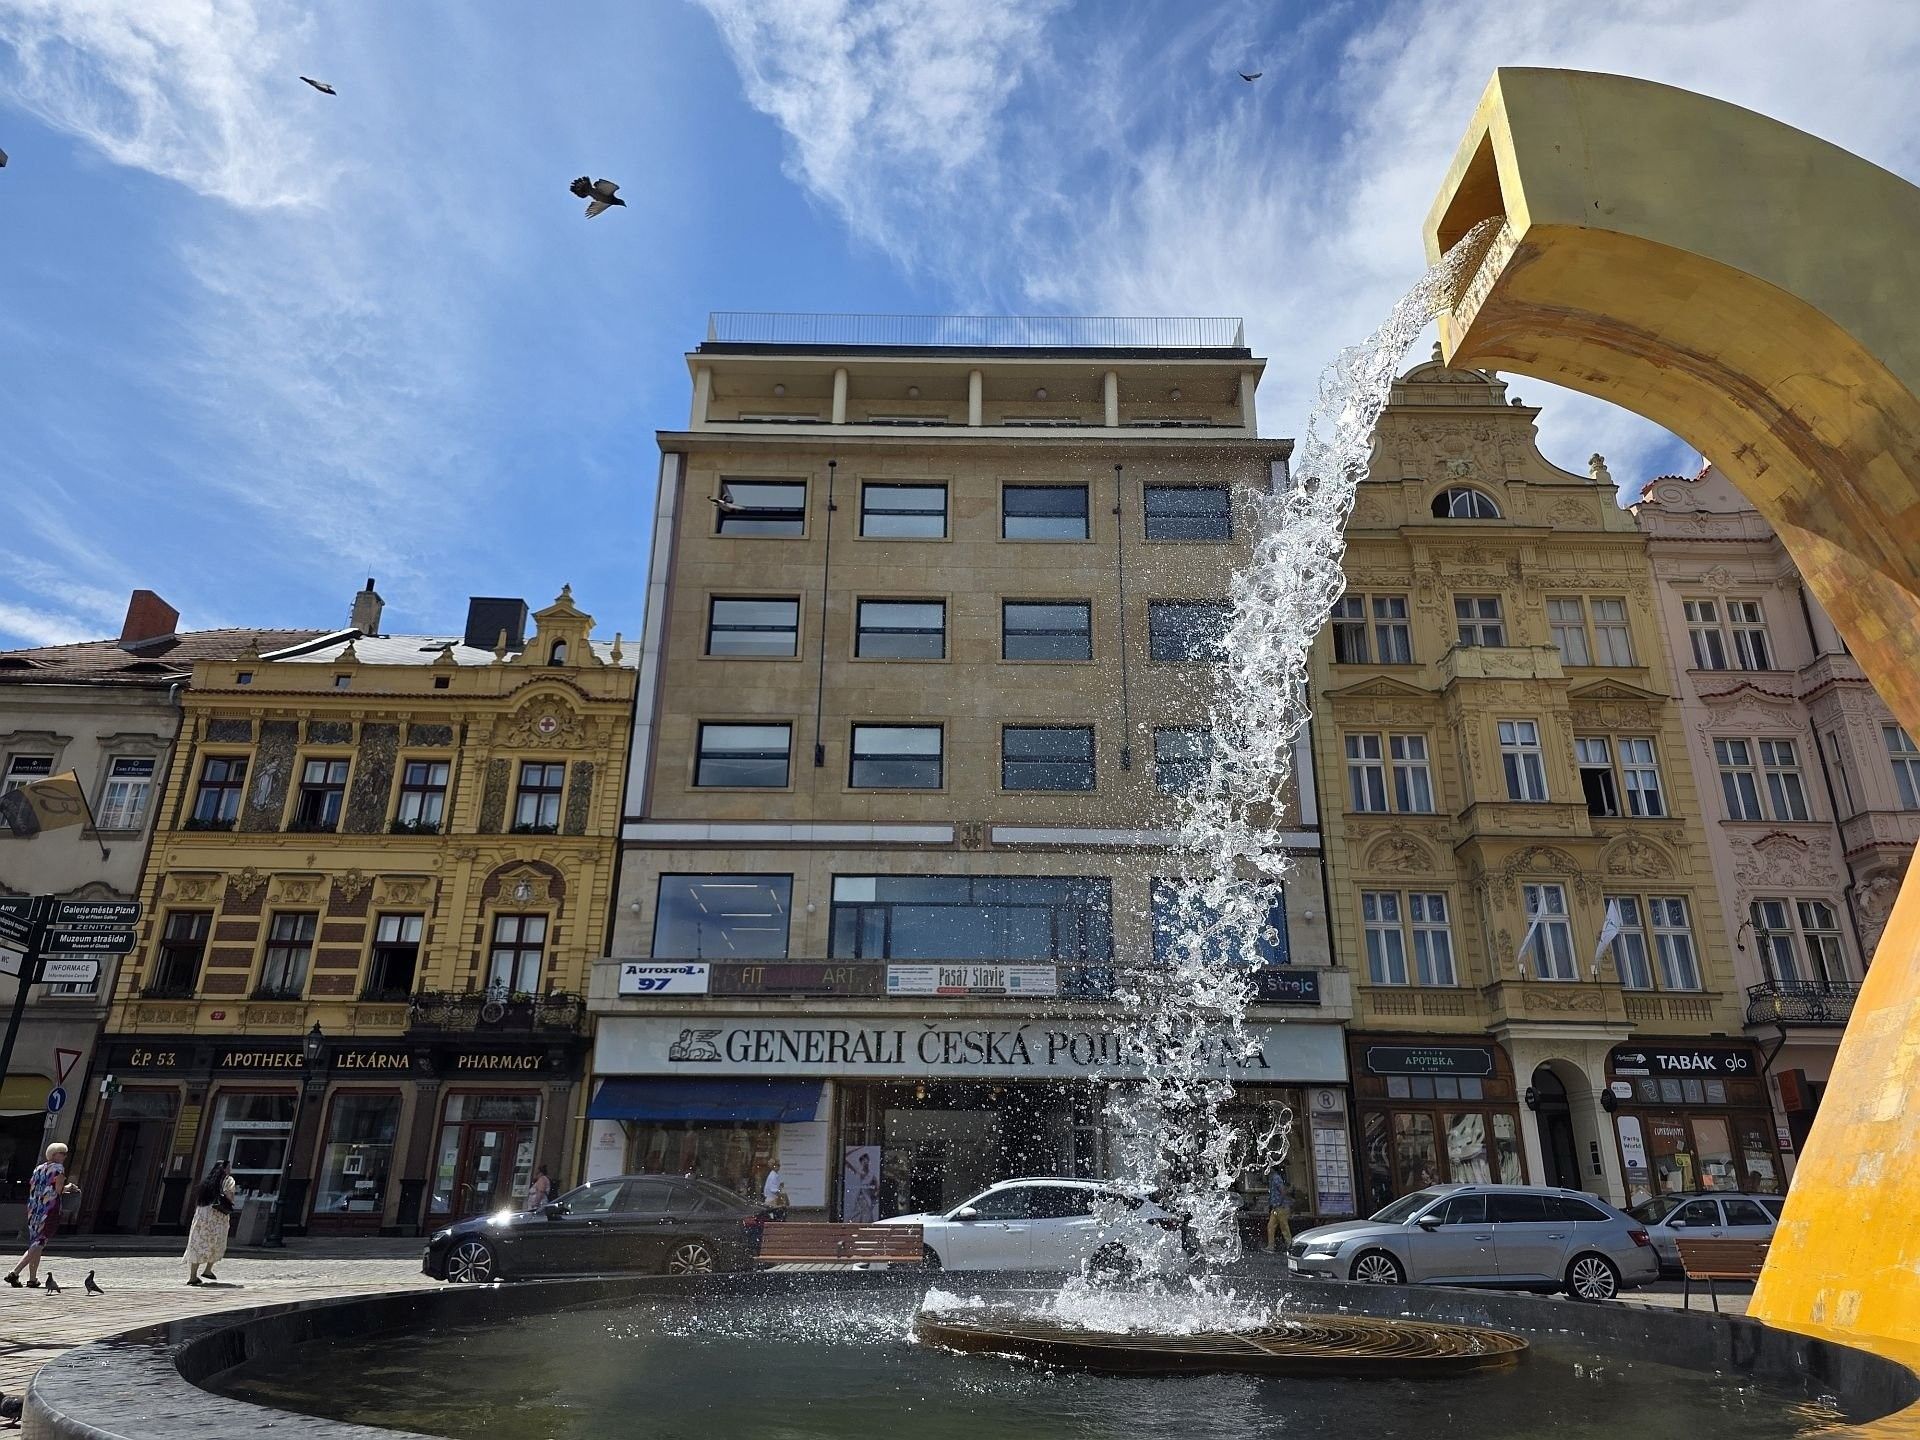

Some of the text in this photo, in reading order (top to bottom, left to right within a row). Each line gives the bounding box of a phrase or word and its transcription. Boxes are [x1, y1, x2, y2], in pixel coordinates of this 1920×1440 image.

[63, 905, 136, 915] Galerie města Plzně
[59, 934, 127, 943] Muzeum strašidel
[742, 967, 766, 984] FIT
[939, 966, 1005, 987] Pasáž Slavie
[638, 978, 672, 991] 97
[1267, 978, 1314, 994] Strejc
[726, 1029, 907, 1064] GENERALI
[917, 1023, 1035, 1067] ČESKÁ
[221, 1053, 304, 1068] APOTHEKE
[336, 1052, 410, 1069] LÉKÁRNA
[457, 1055, 543, 1070] PHARMACY
[1405, 1056, 1455, 1066] APOTEKA
[1656, 1052, 1717, 1071] TABÁK
[1725, 1053, 1747, 1072] glo
[1322, 1094, 1331, 1106] R
[1623, 1135, 1640, 1143] Party
